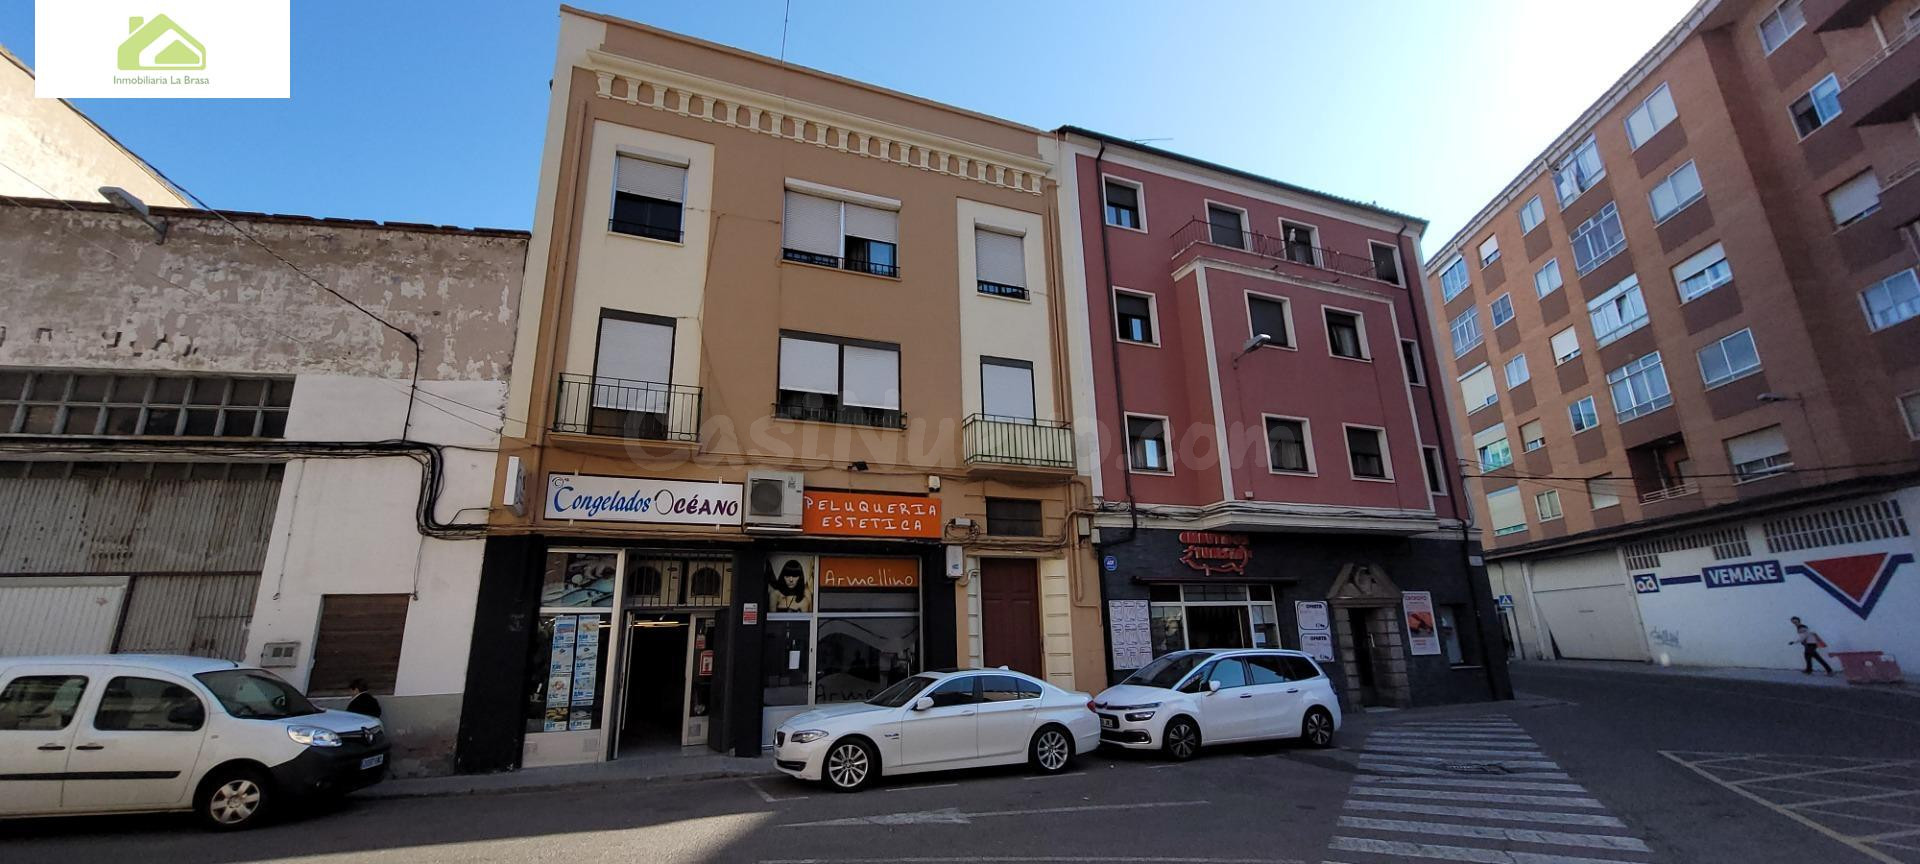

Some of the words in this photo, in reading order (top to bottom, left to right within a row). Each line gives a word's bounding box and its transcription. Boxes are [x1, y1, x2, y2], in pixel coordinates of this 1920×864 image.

[554, 486, 651, 517] Congelados
[804, 496, 938, 516] PELUQUERIA
[821, 516, 922, 531] ESTETICA
[825, 568, 914, 587] Armellino
[1707, 563, 1778, 586] VEMARE
